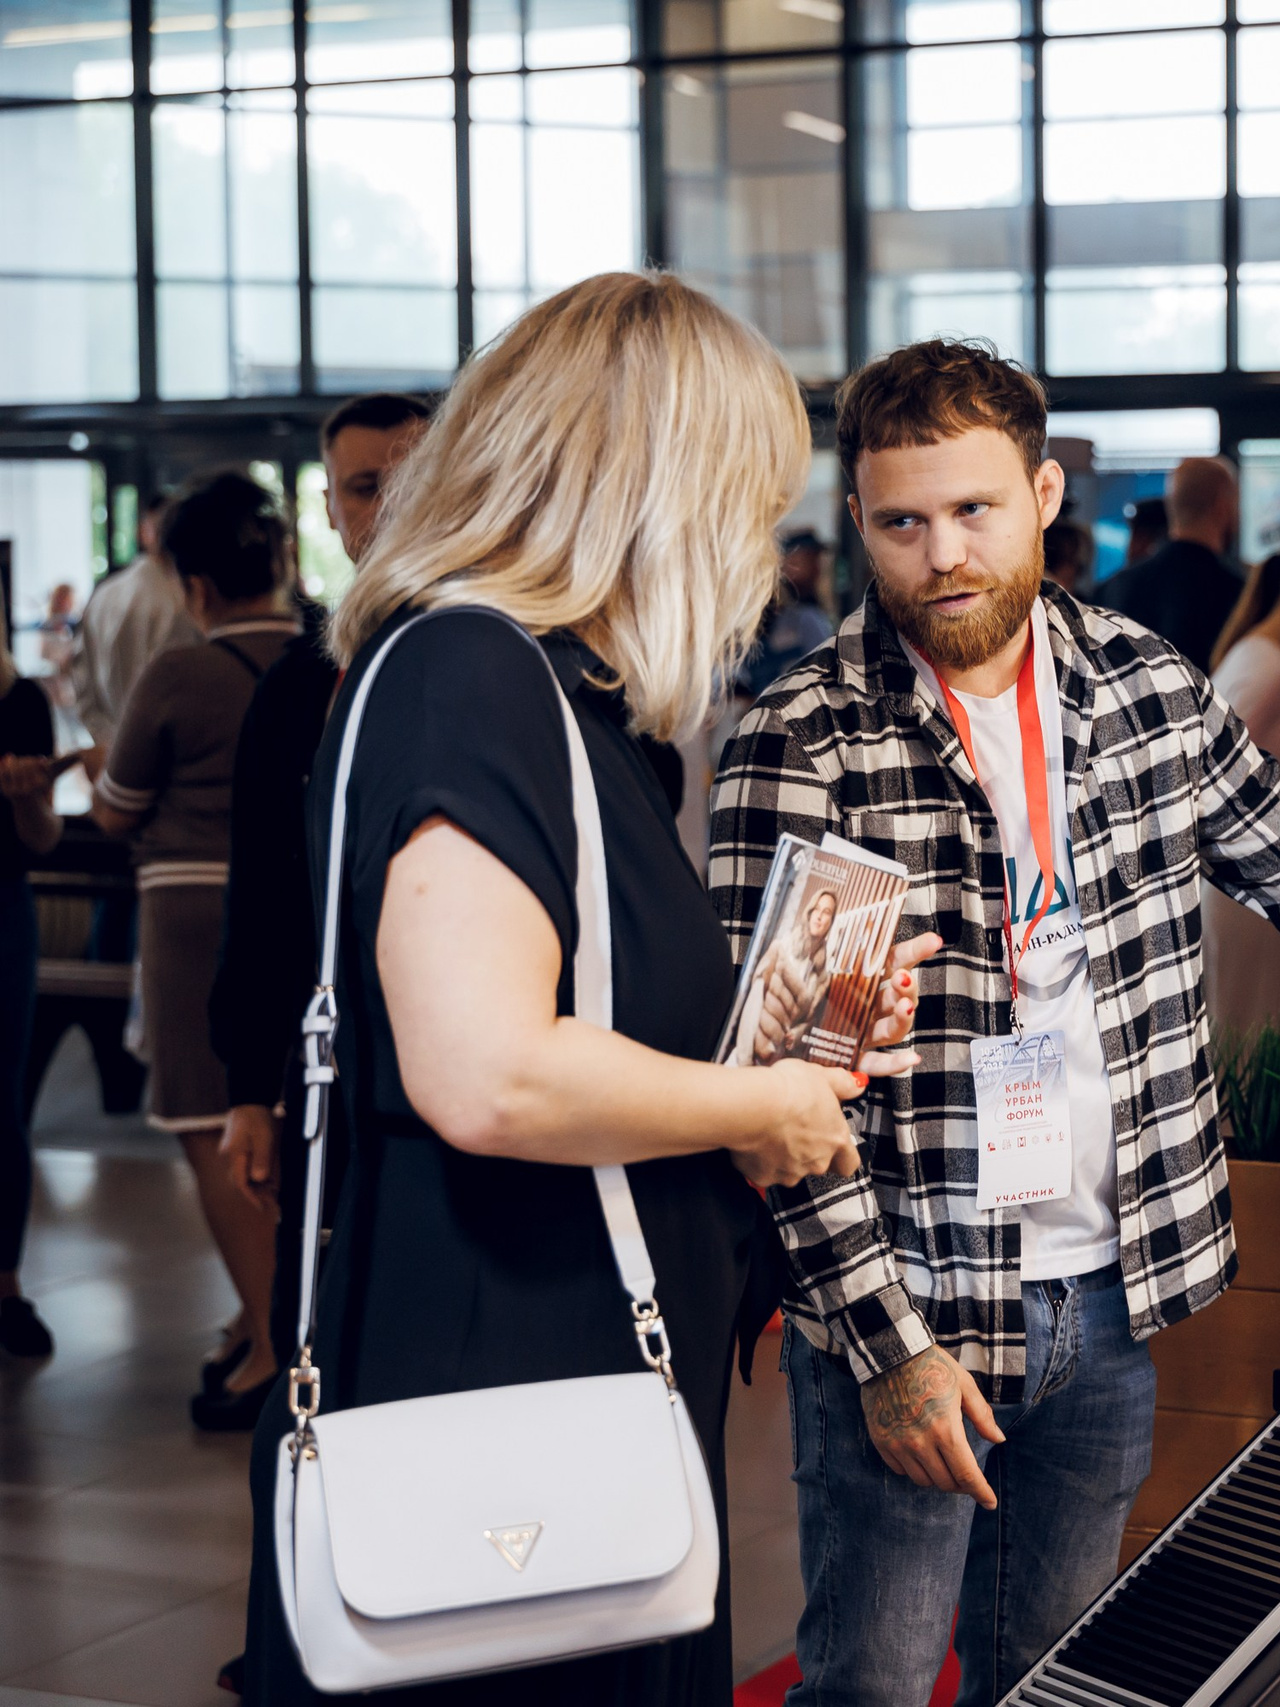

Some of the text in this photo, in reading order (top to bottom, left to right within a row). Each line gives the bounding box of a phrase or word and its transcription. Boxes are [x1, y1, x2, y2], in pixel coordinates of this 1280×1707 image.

[981, 1061, 1004, 1073] 2025
[1005, 1080, 1041, 1093] КРЫМ
[1005, 1093, 1042, 1107] УРБАН
[1006, 1108, 1044, 1121] ФОРУМ
[996, 1187, 1055, 1203] УЧАСТНИК
